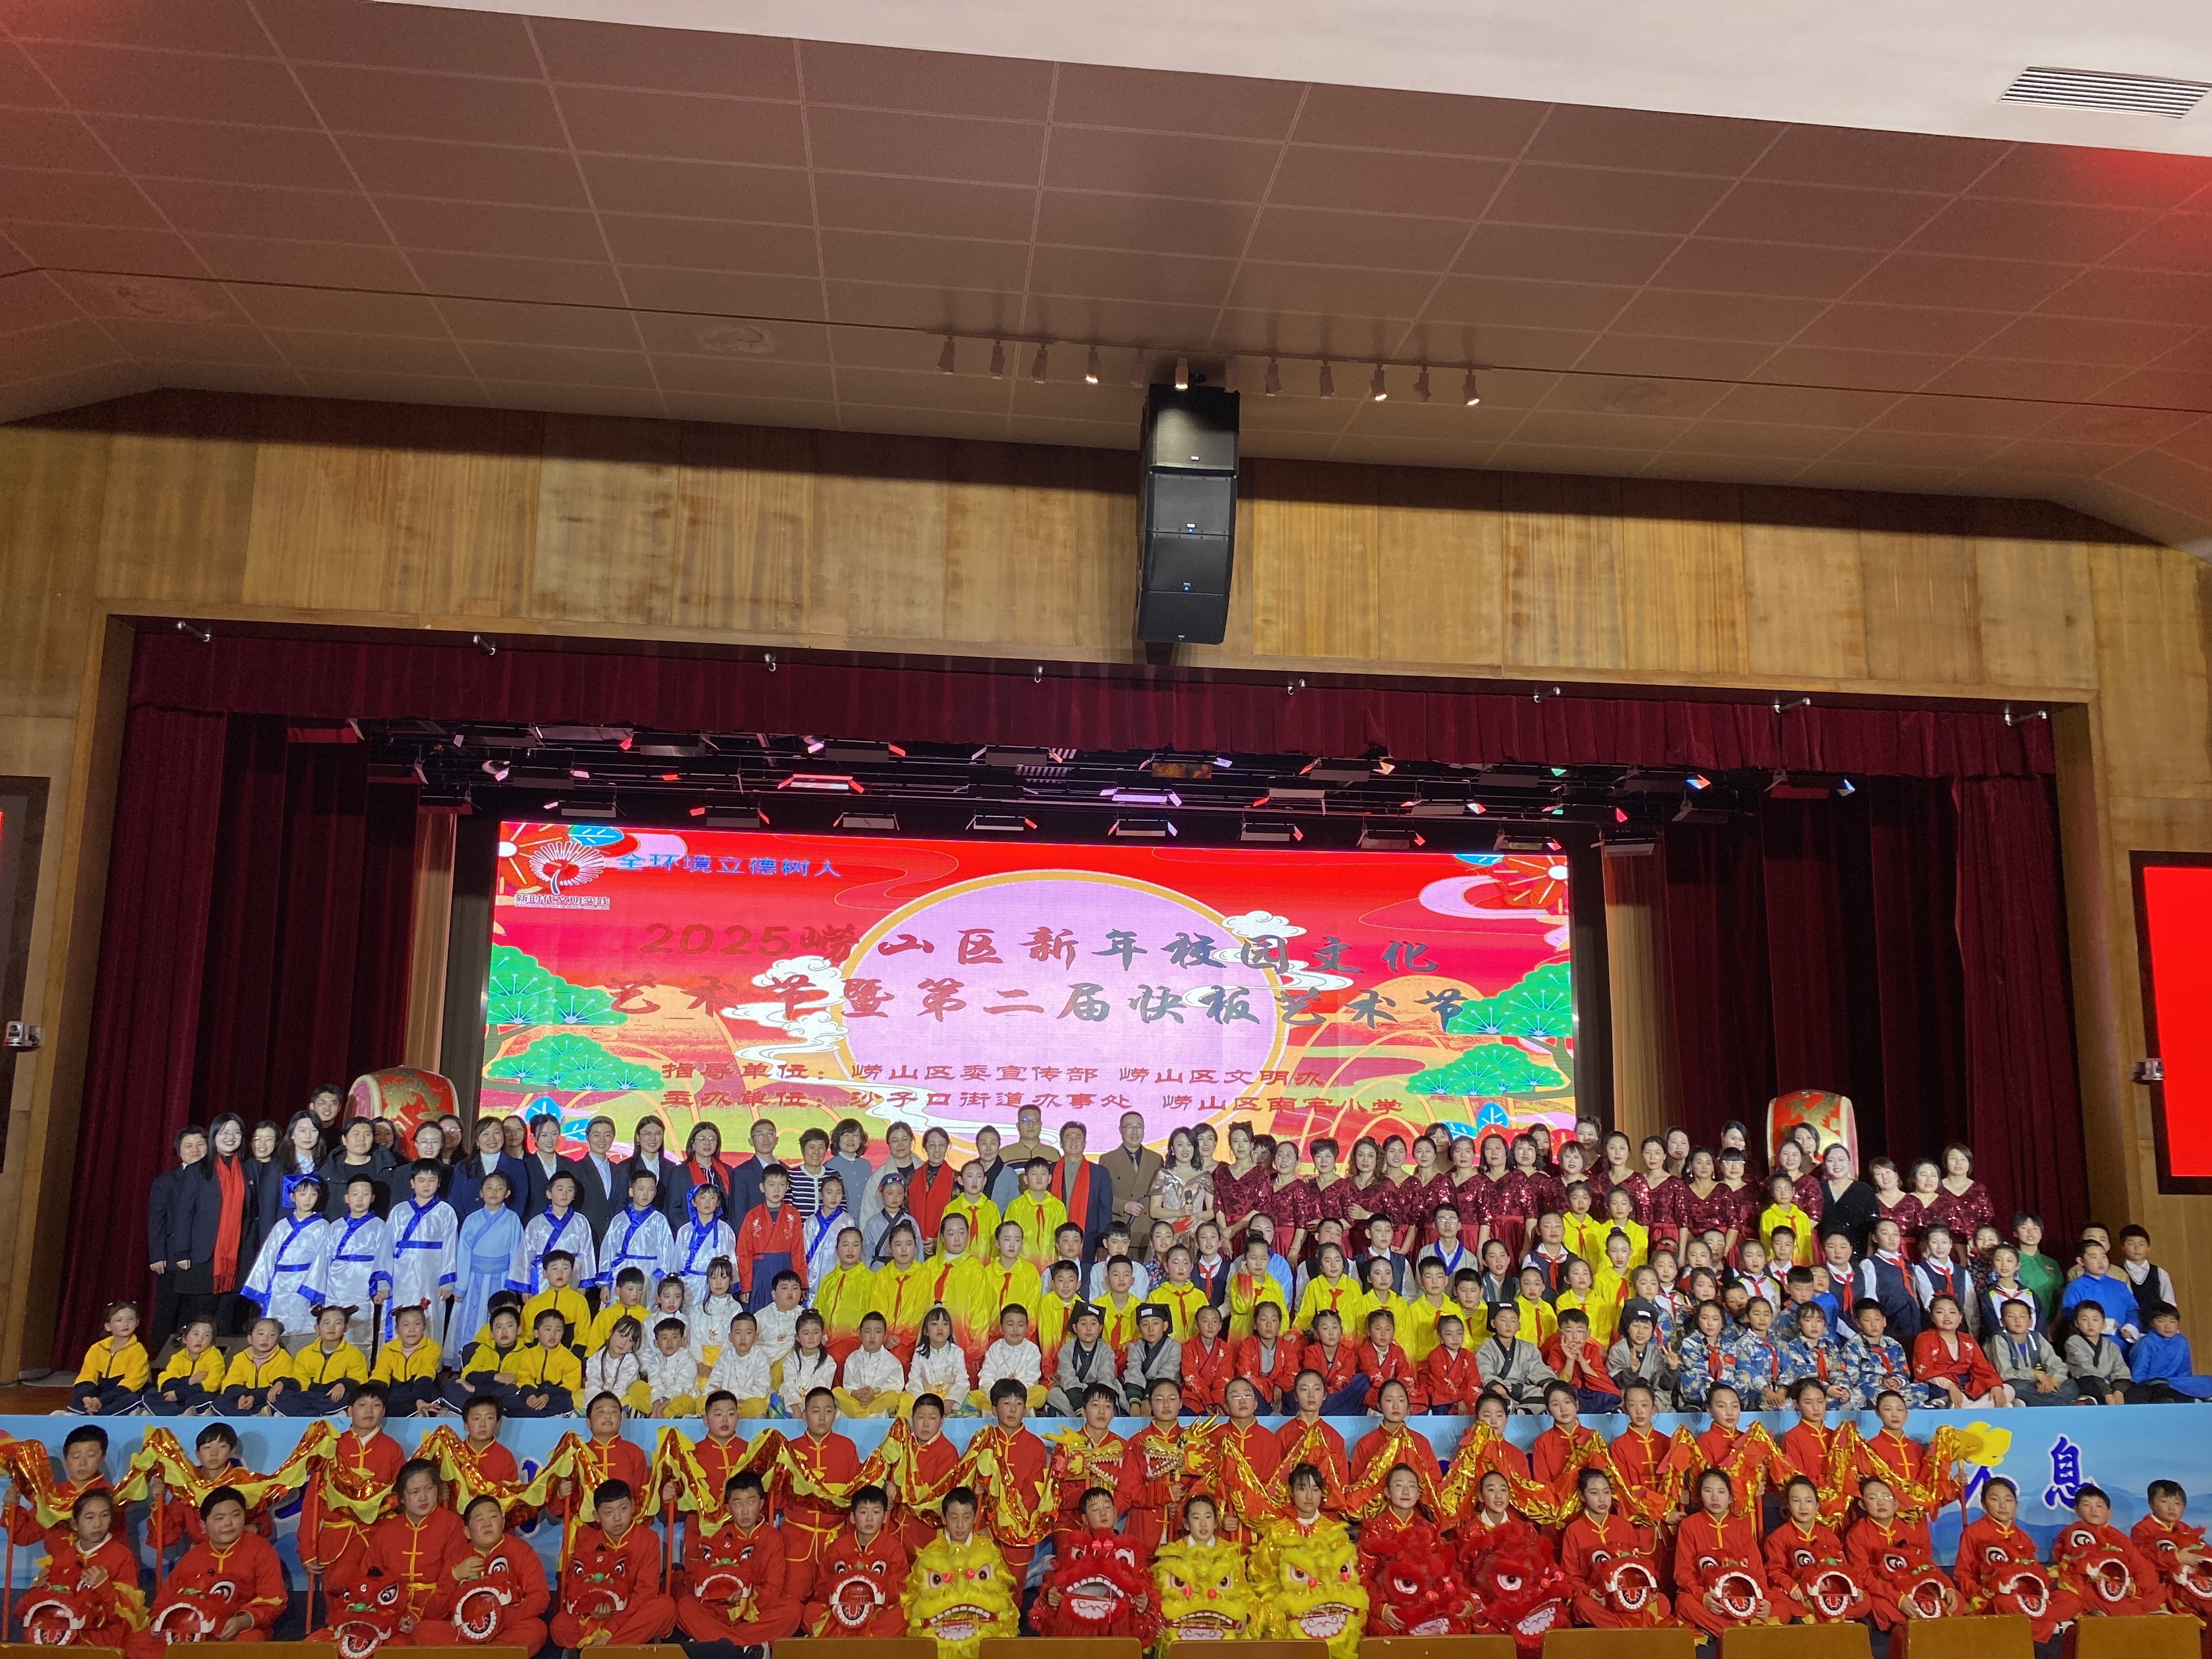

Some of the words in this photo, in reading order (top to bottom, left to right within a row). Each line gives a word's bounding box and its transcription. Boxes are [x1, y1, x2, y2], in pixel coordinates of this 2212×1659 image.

[617, 852, 842, 878] 全环境立德树人
[515, 895, 610, 905] 新时代文明实践
[608, 975, 1469, 1032] 艺术节暨第二届快板艺术节
[1120, 1068, 1325, 1086] 崂山区文明办
